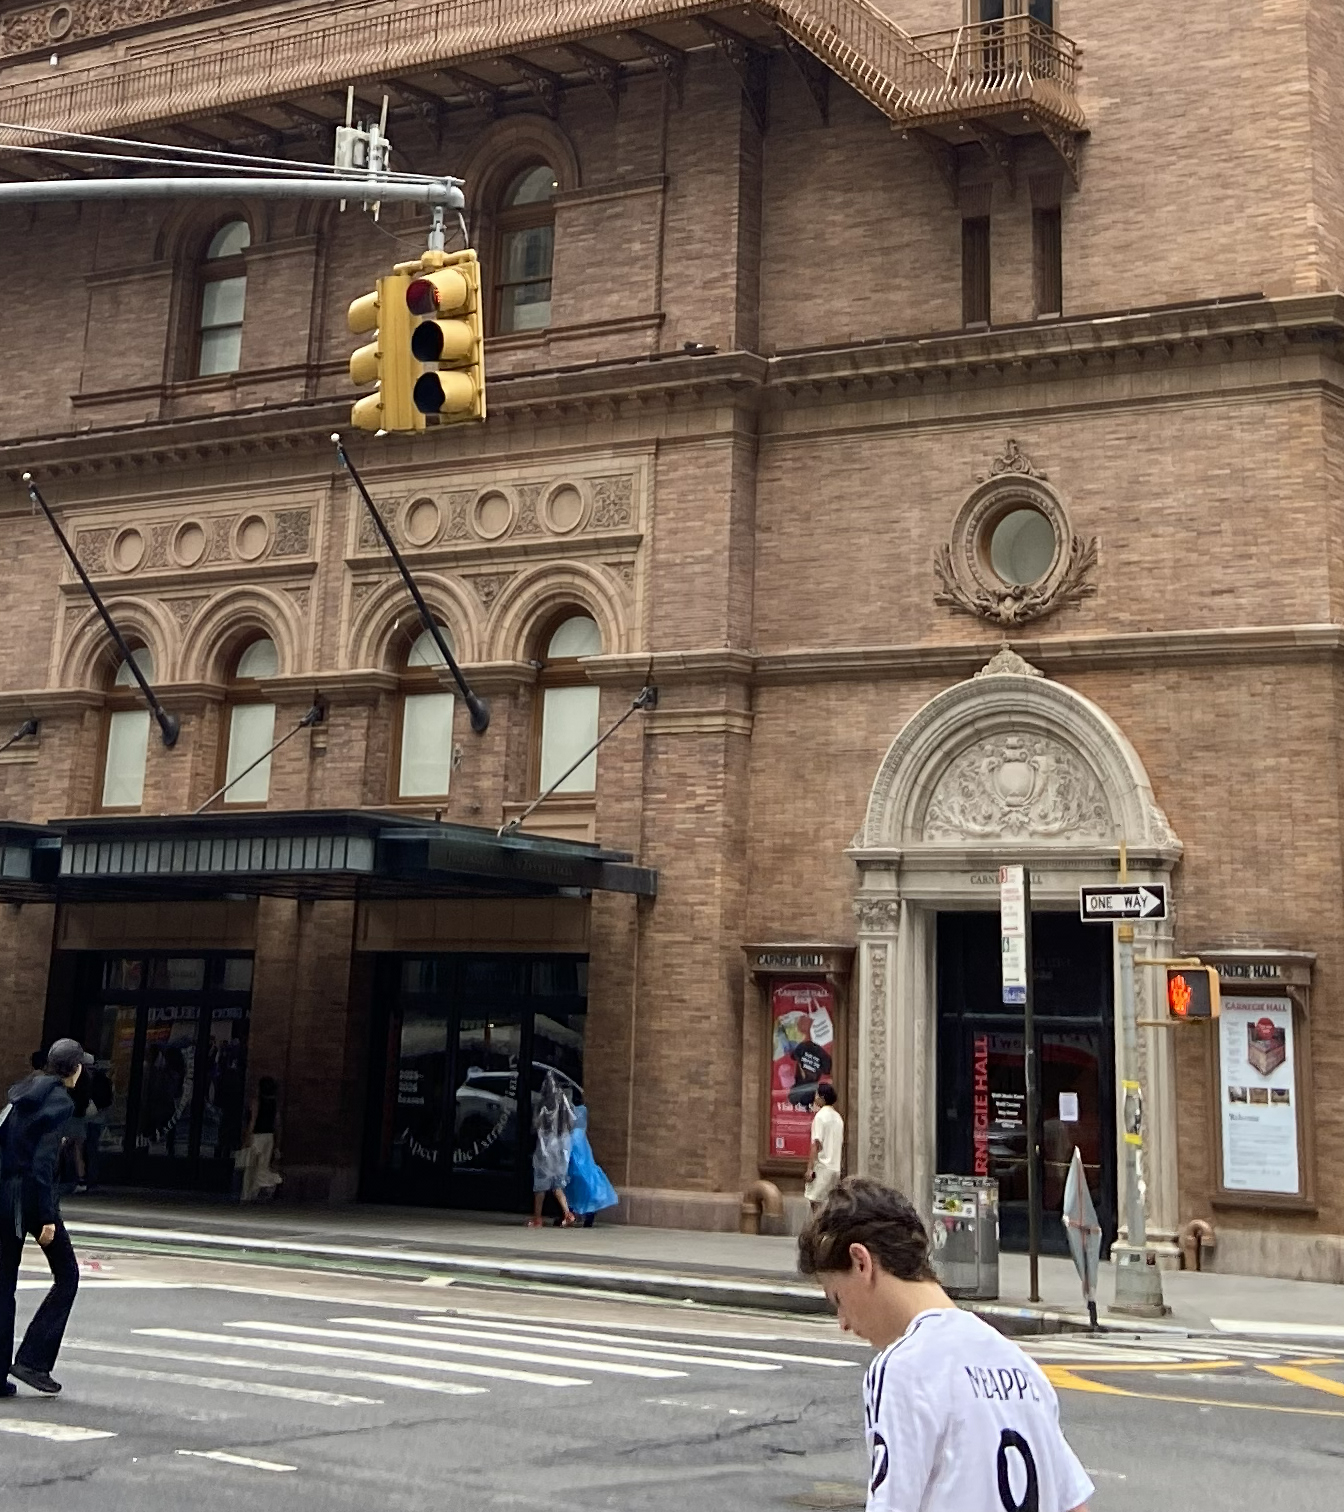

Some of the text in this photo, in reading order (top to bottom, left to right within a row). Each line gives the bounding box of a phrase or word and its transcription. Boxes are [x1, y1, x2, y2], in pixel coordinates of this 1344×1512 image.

[1090, 895, 1149, 910] ONE WAY
[758, 953, 824, 966] CARNEGIE HALL
[1255, 964, 1281, 978] HALL
[1224, 1001, 1288, 1012] CARNEGIE HALL
[973, 1035, 988, 1175] RNEGIE HALL
